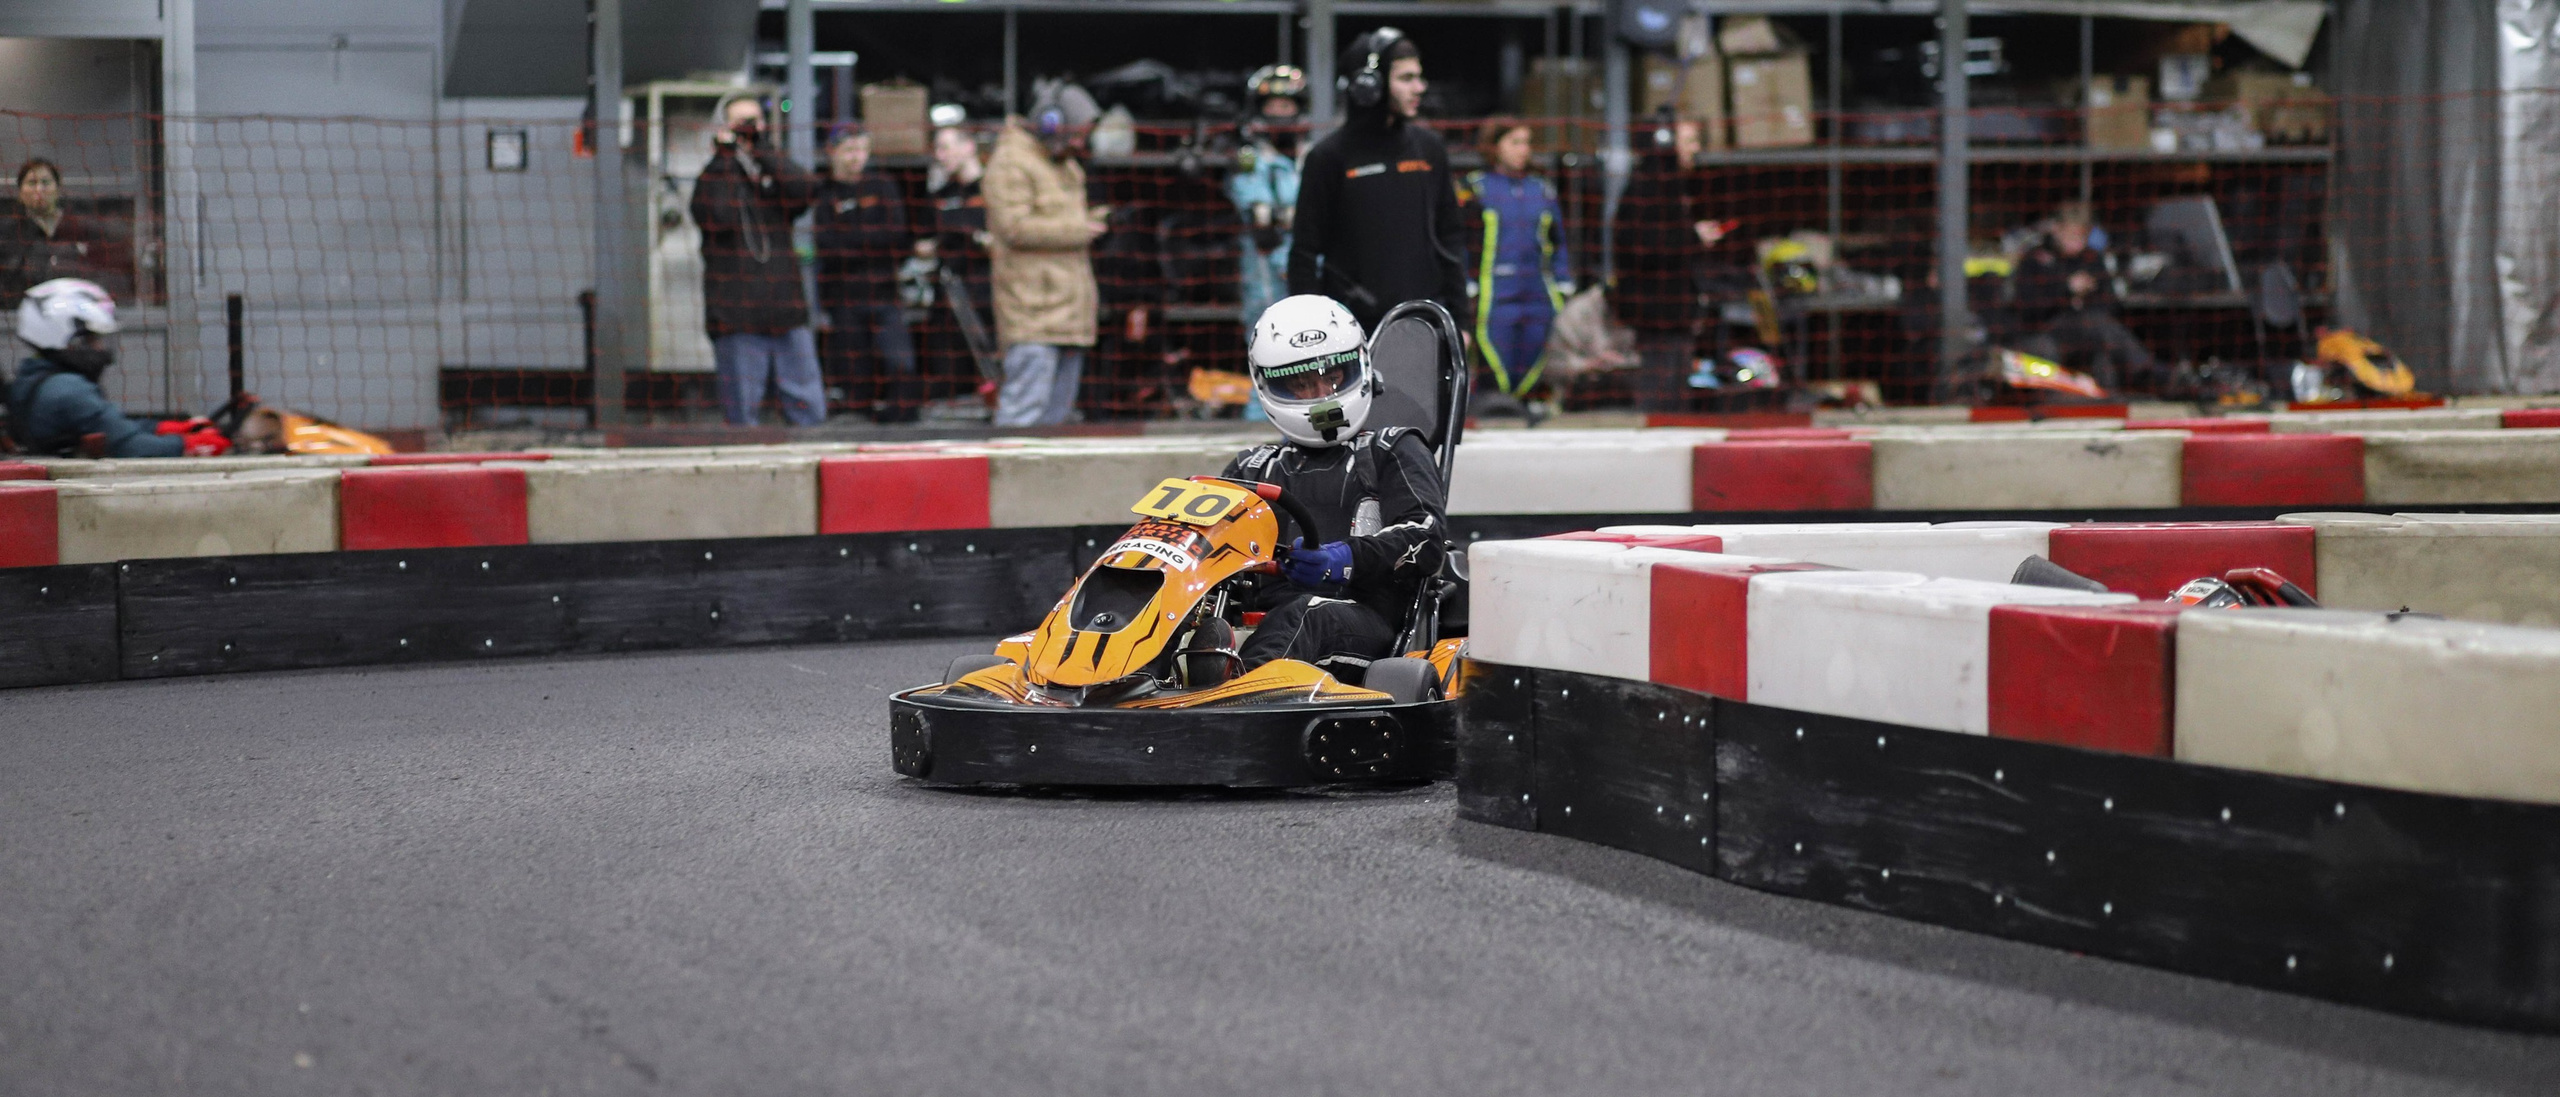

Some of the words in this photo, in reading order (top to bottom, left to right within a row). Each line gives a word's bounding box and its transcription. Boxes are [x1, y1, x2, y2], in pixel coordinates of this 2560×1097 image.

[1263, 361, 1325, 378] Hammer
[1328, 351, 1358, 367] Time
[1151, 485, 1231, 518] 10
